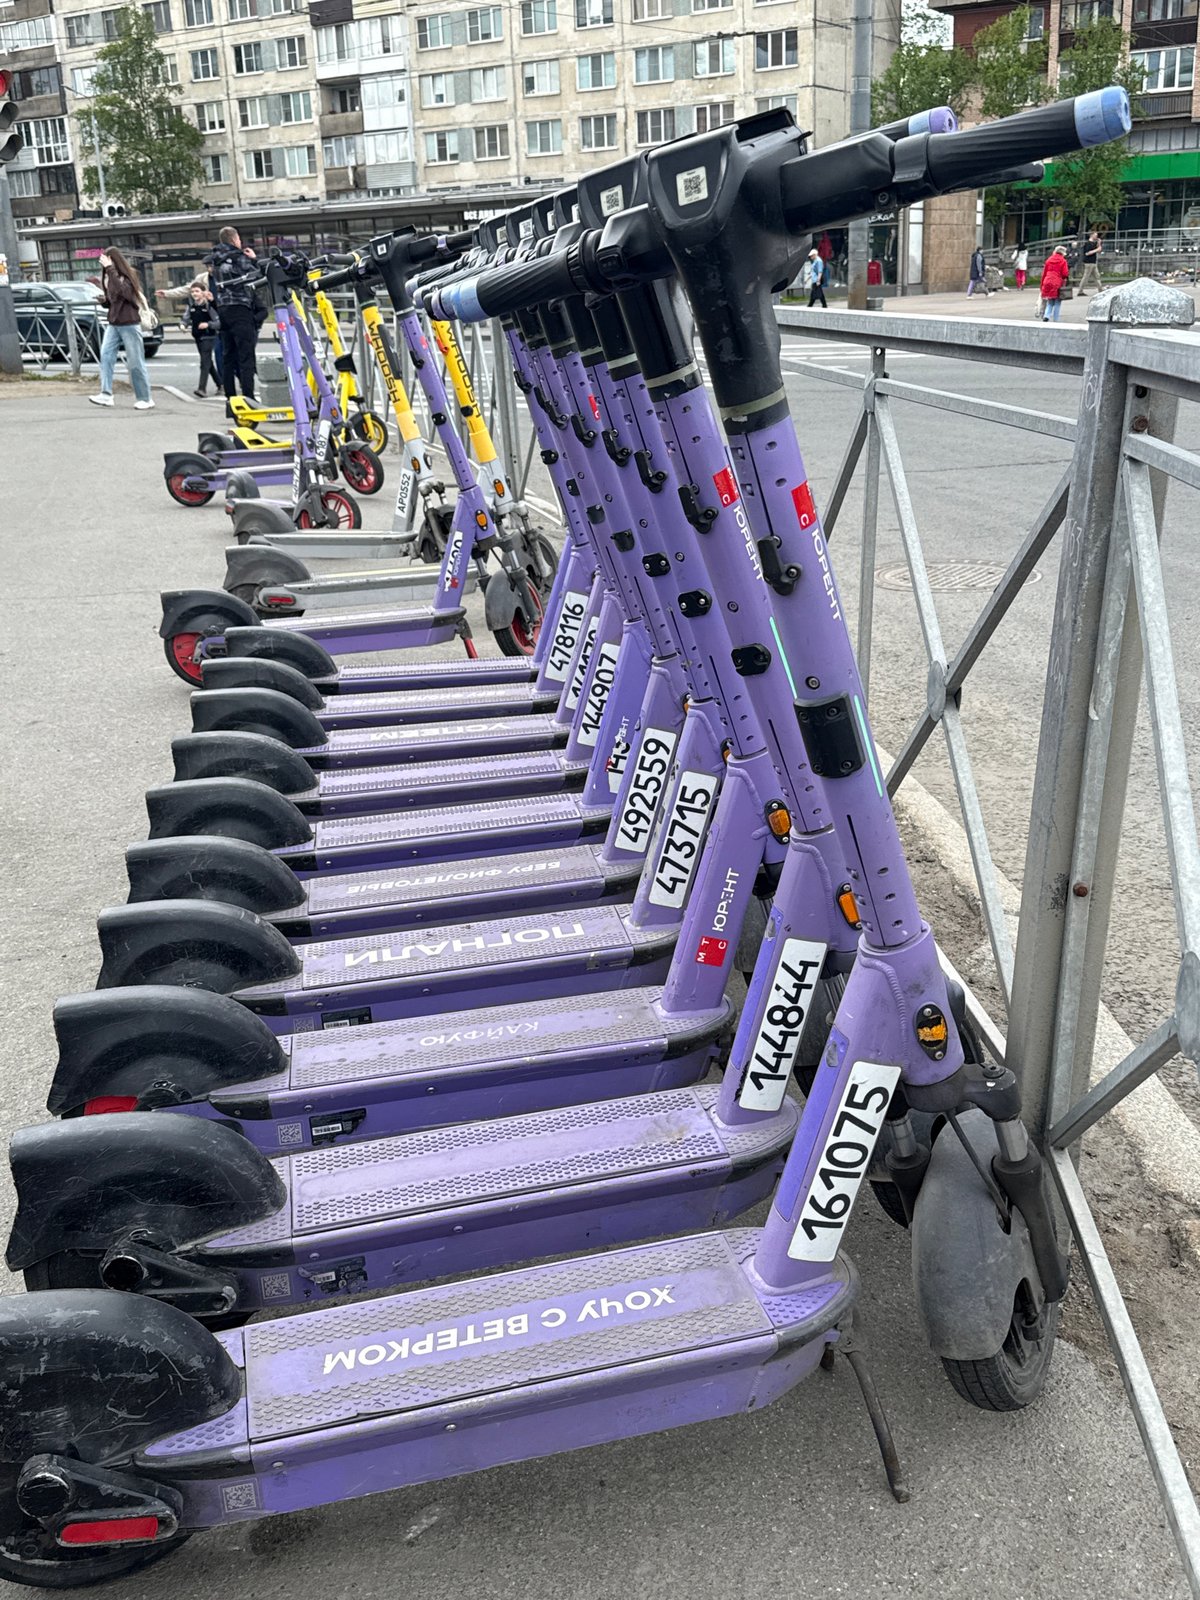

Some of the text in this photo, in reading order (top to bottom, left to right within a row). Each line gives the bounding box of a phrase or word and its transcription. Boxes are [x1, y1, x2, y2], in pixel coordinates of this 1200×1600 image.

[368, 321, 400, 403] WHOOSH
[397, 473, 411, 513] AP0552
[733, 506, 764, 581] ЮРЕНТ
[811, 528, 842, 621] ЮРЕНТ
[549, 603, 584, 672] 478116
[370, 723, 511, 740] УСПЕЕМ
[582, 653, 617, 735] 144907
[620, 738, 670, 843] 492559
[346, 861, 561, 894] БЕРУ ФИОЛЕТОВЫЕ
[655, 785, 710, 895] 473715
[712, 868, 740, 932] ЮРЕНТ
[344, 923, 585, 968] ПОГНАЛИ
[420, 1021, 539, 1047] КАЙФУЮ
[750, 960, 819, 1091] 144844
[801, 1083, 890, 1241] 161075
[323, 1284, 676, 1375] ХОЧУ С ВЕТЕРКОМ
